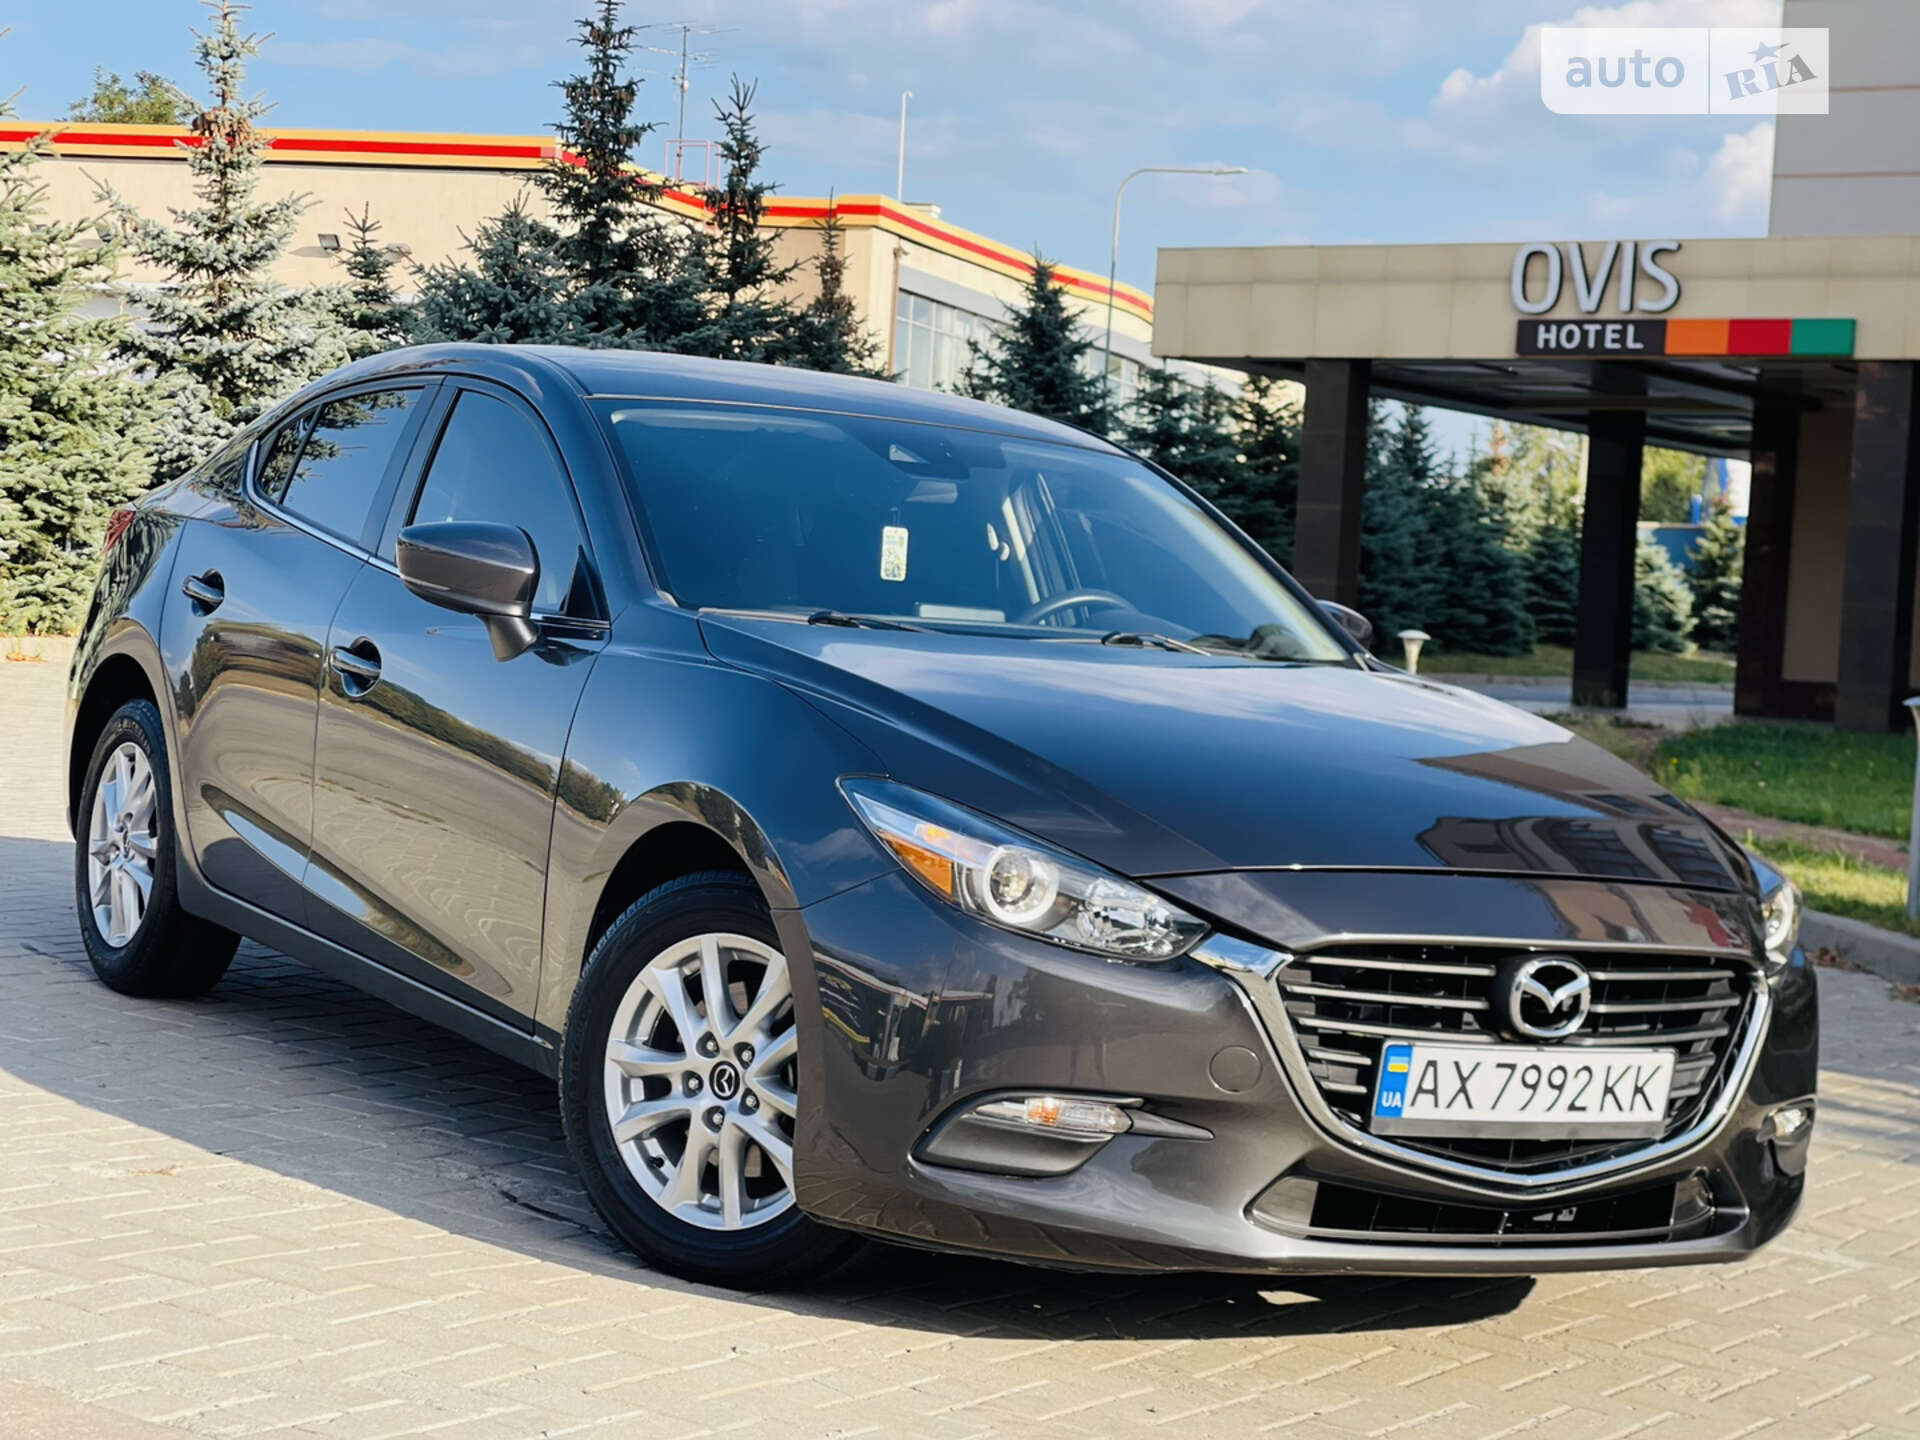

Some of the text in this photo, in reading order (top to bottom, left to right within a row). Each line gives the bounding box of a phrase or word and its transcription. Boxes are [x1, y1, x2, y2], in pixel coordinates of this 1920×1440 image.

[1511, 240, 1683, 314] OVIS
[1536, 323, 1644, 350] HOTEL
[1381, 1091, 1402, 1108] UA
